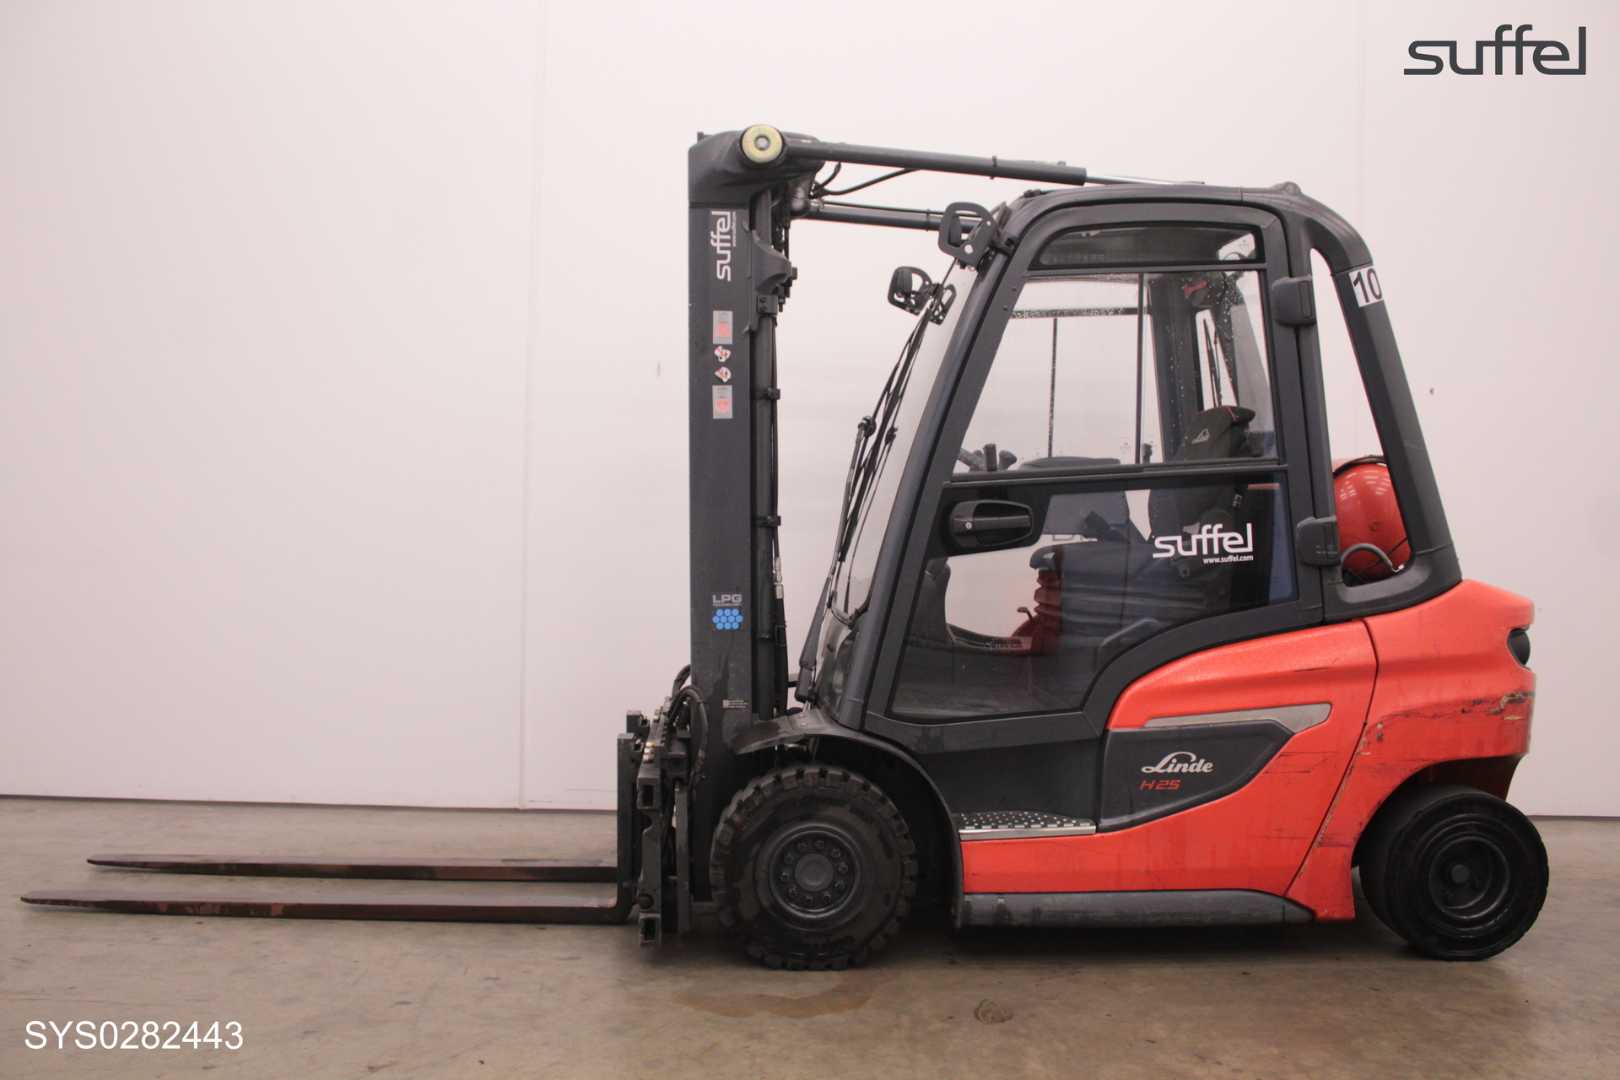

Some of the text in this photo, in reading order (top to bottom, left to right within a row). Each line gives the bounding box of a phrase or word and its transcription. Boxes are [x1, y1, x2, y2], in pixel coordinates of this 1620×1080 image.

[710, 210, 731, 282] suffel
[1152, 522, 1254, 559] suffel
[1203, 555, 1254, 564] www.suffel.com
[712, 594, 742, 604] LPG
[1141, 751, 1214, 774] Linde
[1139, 779, 1181, 791] H25
